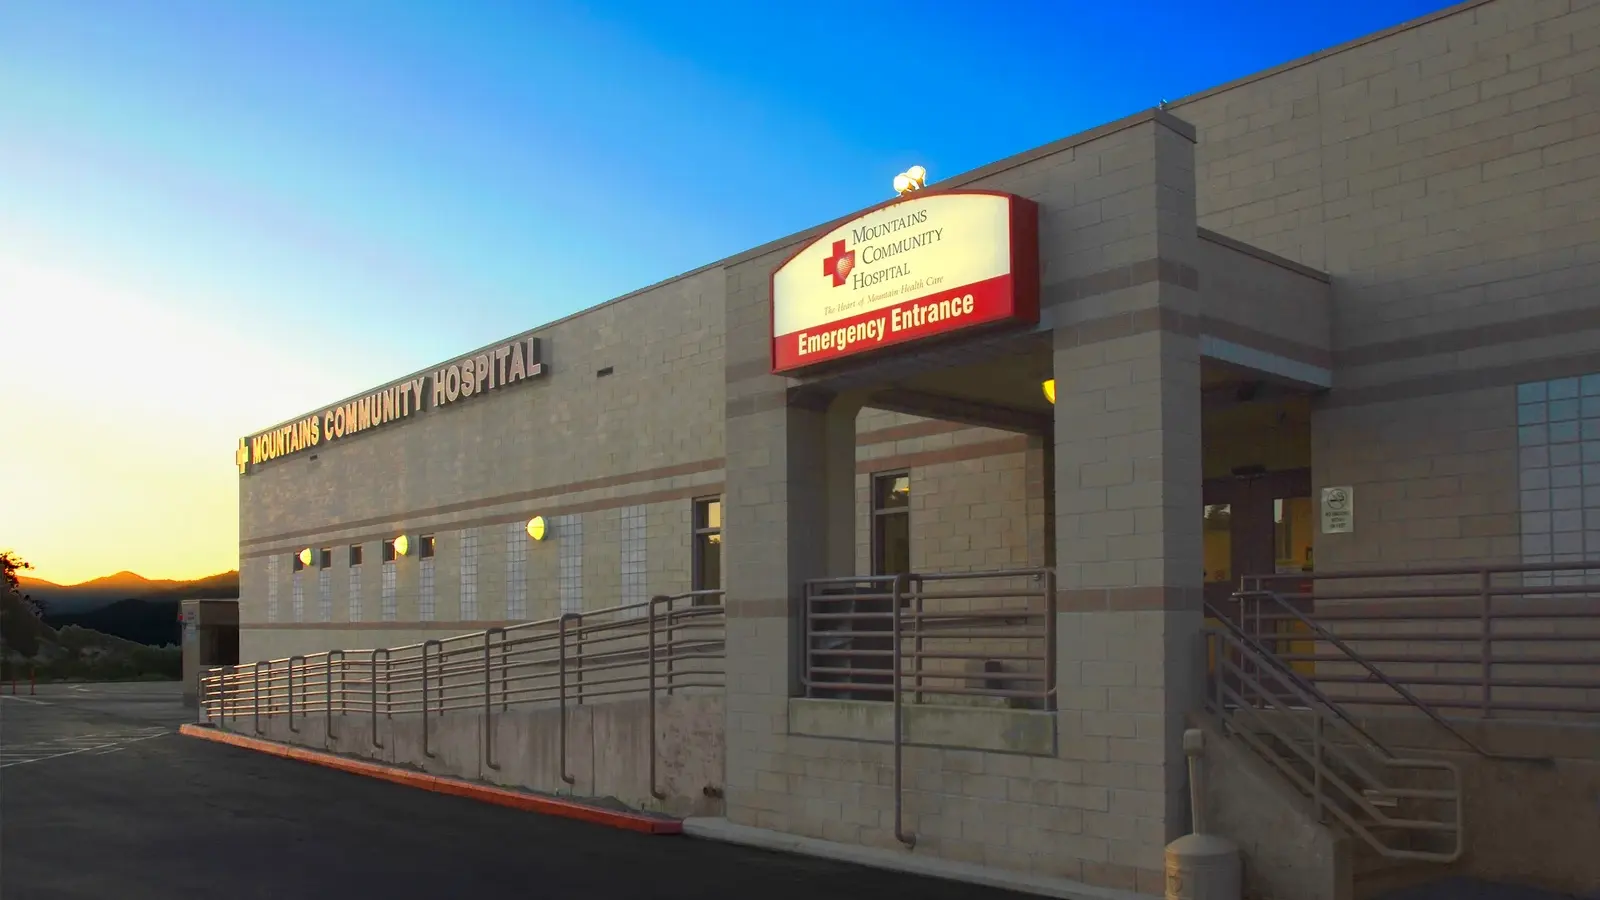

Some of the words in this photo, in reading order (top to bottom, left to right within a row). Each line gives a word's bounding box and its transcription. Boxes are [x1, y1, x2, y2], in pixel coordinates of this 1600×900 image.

[853, 210, 928, 245] MOUNTAINS
[862, 228, 943, 264] COMMUNITY
[824, 306, 836, 316] The
[838, 301, 856, 313] Heart
[858, 299, 865, 308] of
[867, 289, 899, 304] Mountain
[901, 281, 924, 294] Health
[926, 275, 944, 286] Care
[853, 263, 911, 290] HOSPITAL
[798, 317, 886, 356] Emergency
[891, 293, 974, 332] Entrance
[252, 416, 320, 464] MOUNTAINS
[324, 376, 426, 441] COMMUNITY
[433, 337, 541, 407] HOSPITAL
